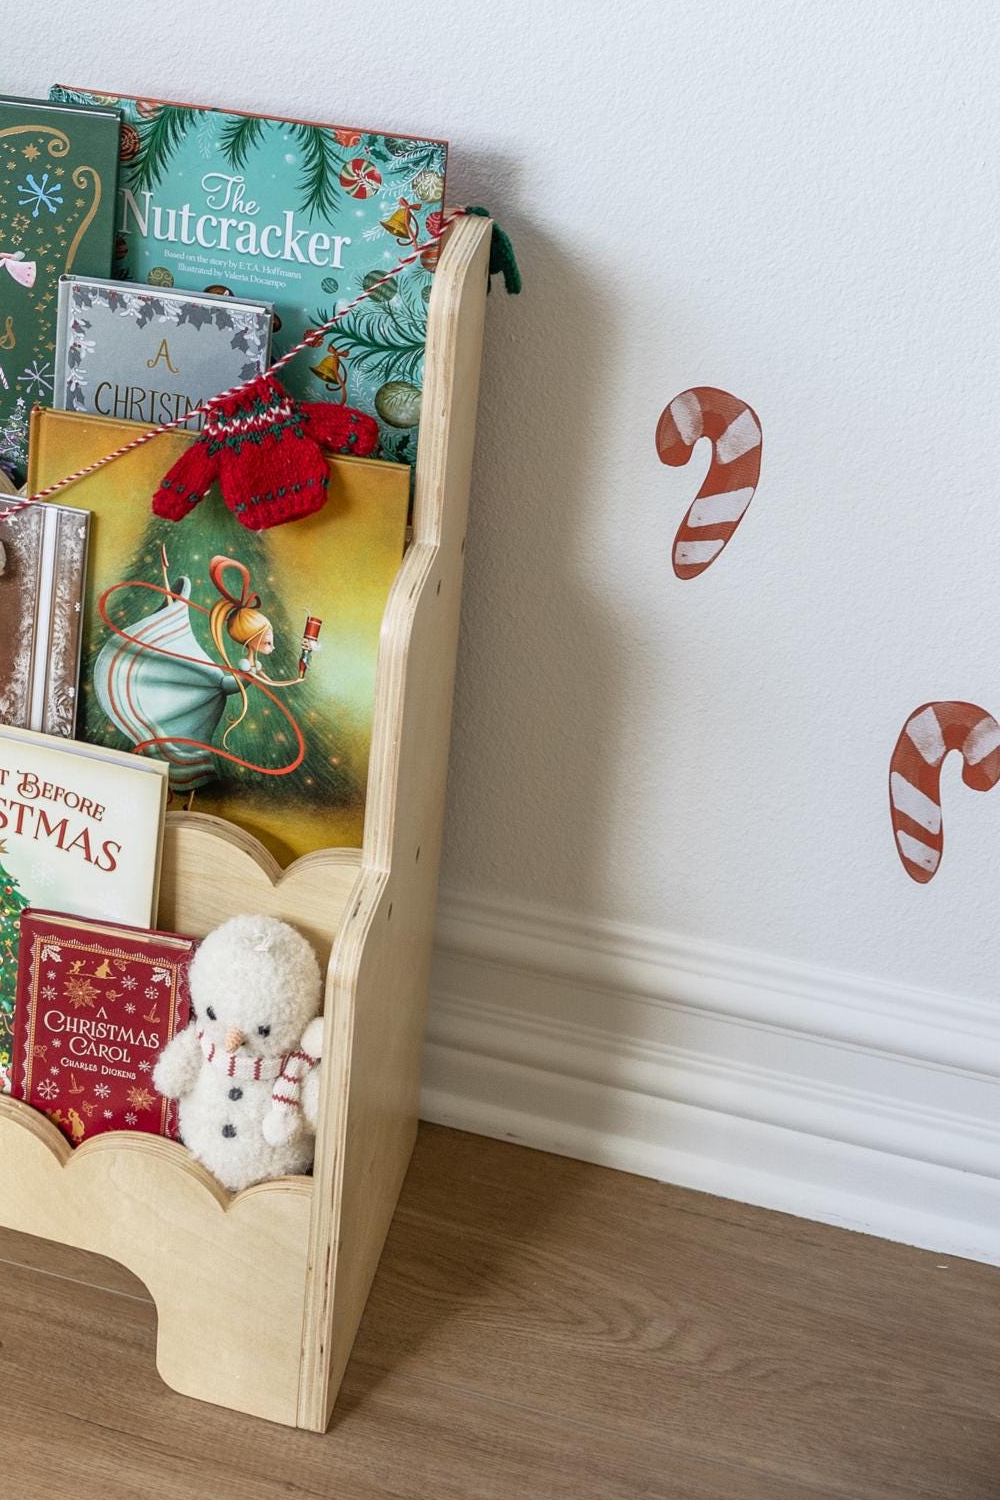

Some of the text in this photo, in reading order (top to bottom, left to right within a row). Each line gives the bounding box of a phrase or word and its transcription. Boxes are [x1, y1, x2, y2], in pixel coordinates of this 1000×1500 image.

[201, 172, 260, 216] The
[118, 187, 352, 269] Nutcracker
[164, 249, 185, 261] Based
[185, 254, 196, 262] on
[197, 254, 209, 265] the
[209, 257, 230, 270] story
[228, 260, 238, 270] by
[262, 264, 302, 280] Hoffmann
[177, 263, 287, 290] Illustrated by Valeria Docampo
[147, 339, 179, 374] A
[95, 382, 208, 431] CHRISTM
[16, 769, 106, 822] BEFORE
[43, 1009, 160, 1049] CHRISTMAS
[95, 1006, 108, 1020] A
[69, 1036, 131, 1064] CAROL
[60, 1056, 137, 1080] CHARLES DICKENS
